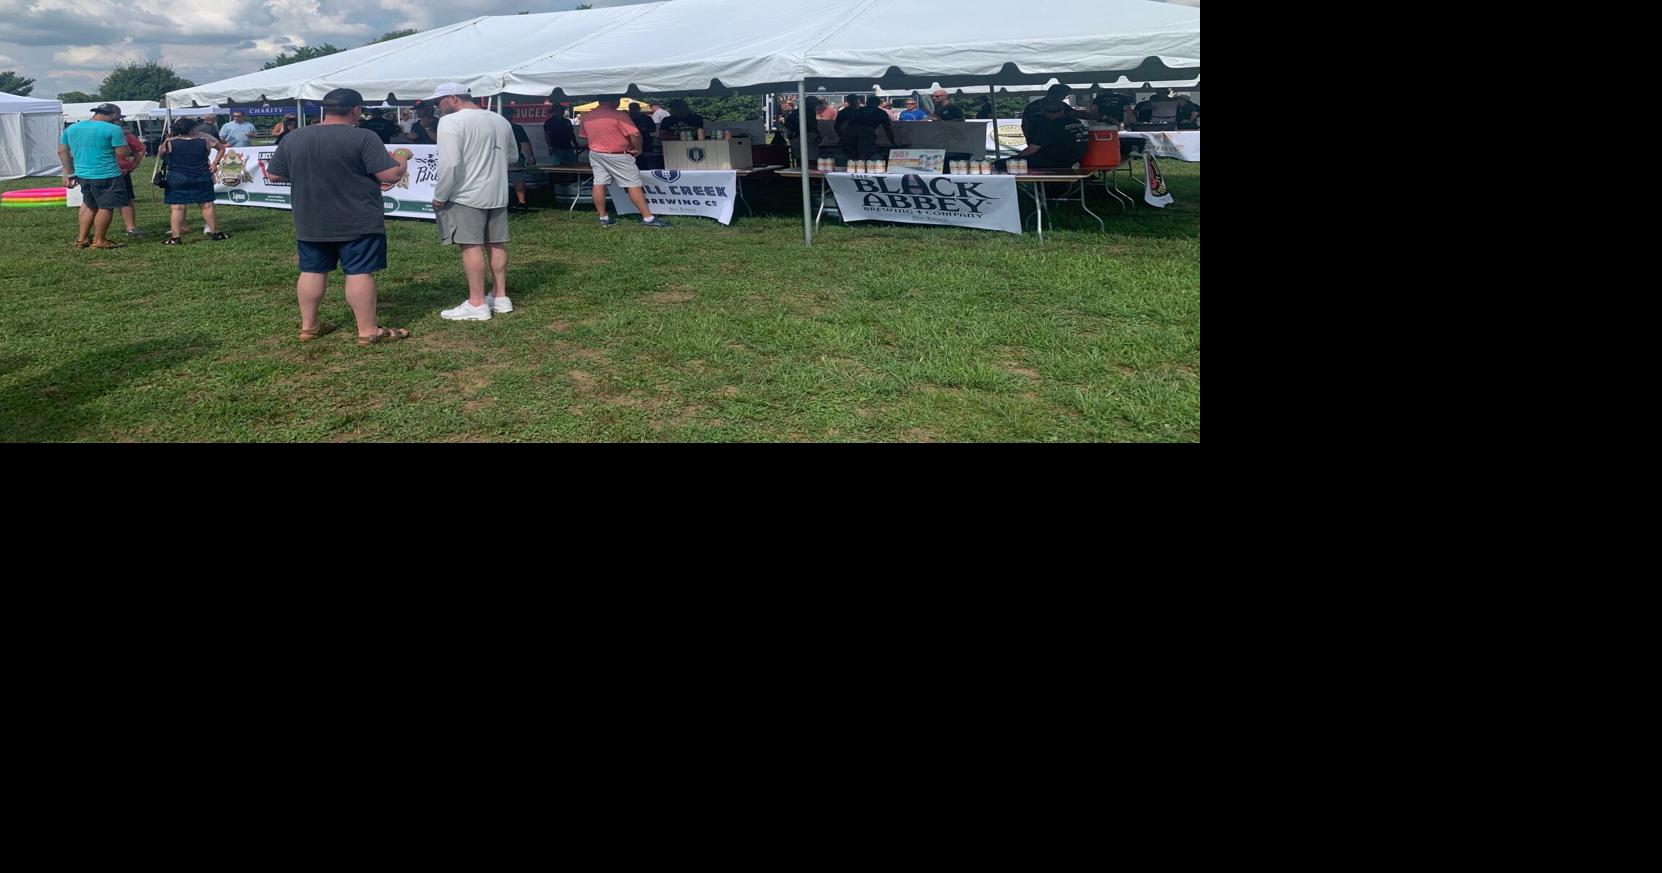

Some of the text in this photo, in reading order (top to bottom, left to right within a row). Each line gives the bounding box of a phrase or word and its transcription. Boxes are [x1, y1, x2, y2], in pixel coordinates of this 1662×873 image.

[669, 185, 728, 198] CREEK
[850, 174, 1000, 199] BLACK
[861, 193, 988, 213] ABBEY
[863, 207, 914, 215] BREWING
[925, 210, 984, 219] COMPANY
